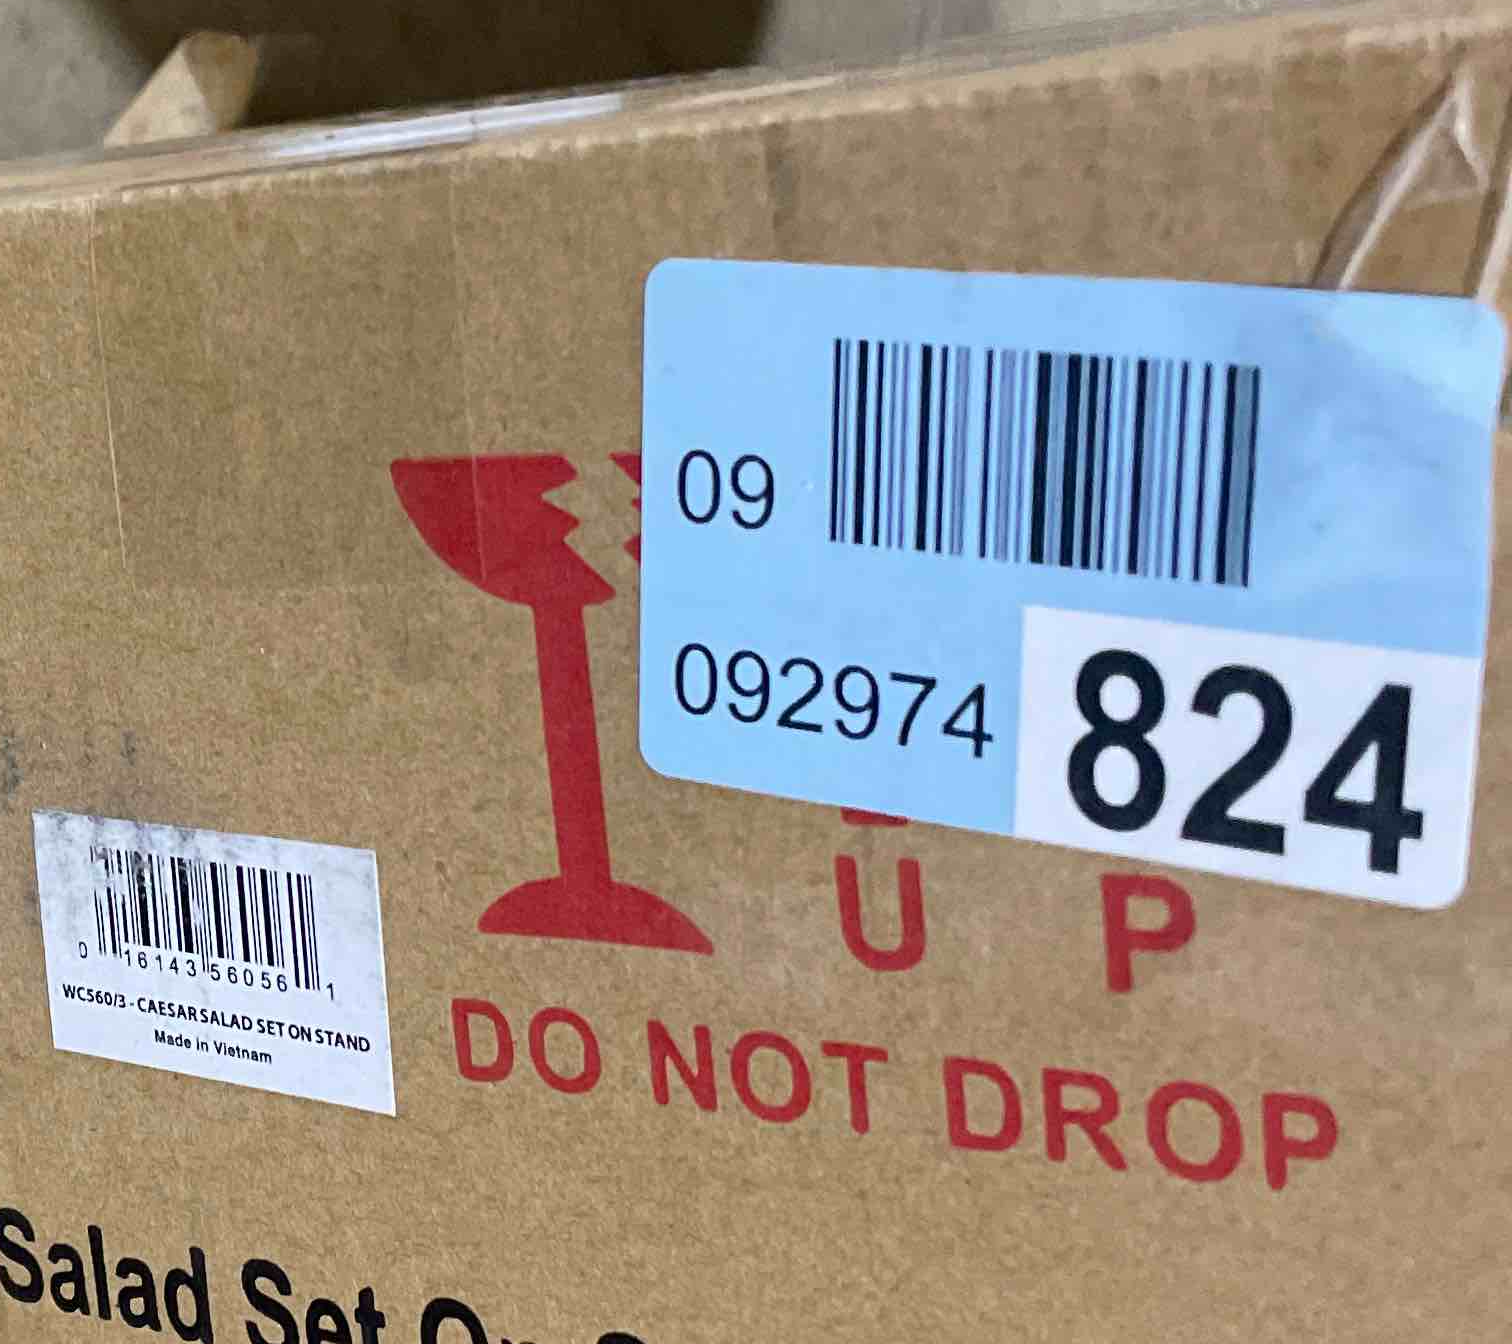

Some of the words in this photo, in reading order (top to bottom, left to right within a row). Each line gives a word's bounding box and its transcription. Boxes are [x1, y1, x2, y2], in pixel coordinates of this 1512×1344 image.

[676, 449, 776, 530] 09
[674, 642, 995, 761] 092974
[1066, 648, 1424, 876] 824
[62, 983, 126, 1009] WC560/3
[137, 997, 198, 1022] CAESAR
[200, 1008, 253, 1031] SALAD
[256, 1019, 285, 1038] SET
[288, 1023, 313, 1043] ON
[314, 1029, 370, 1053] STAND
[154, 1029, 191, 1050] Made
[196, 1034, 209, 1053] in
[214, 1041, 272, 1064] Vietnam
[451, 997, 602, 1096] DO
[646, 1018, 889, 1136] NOT
[943, 1056, 1339, 1192] DROP
